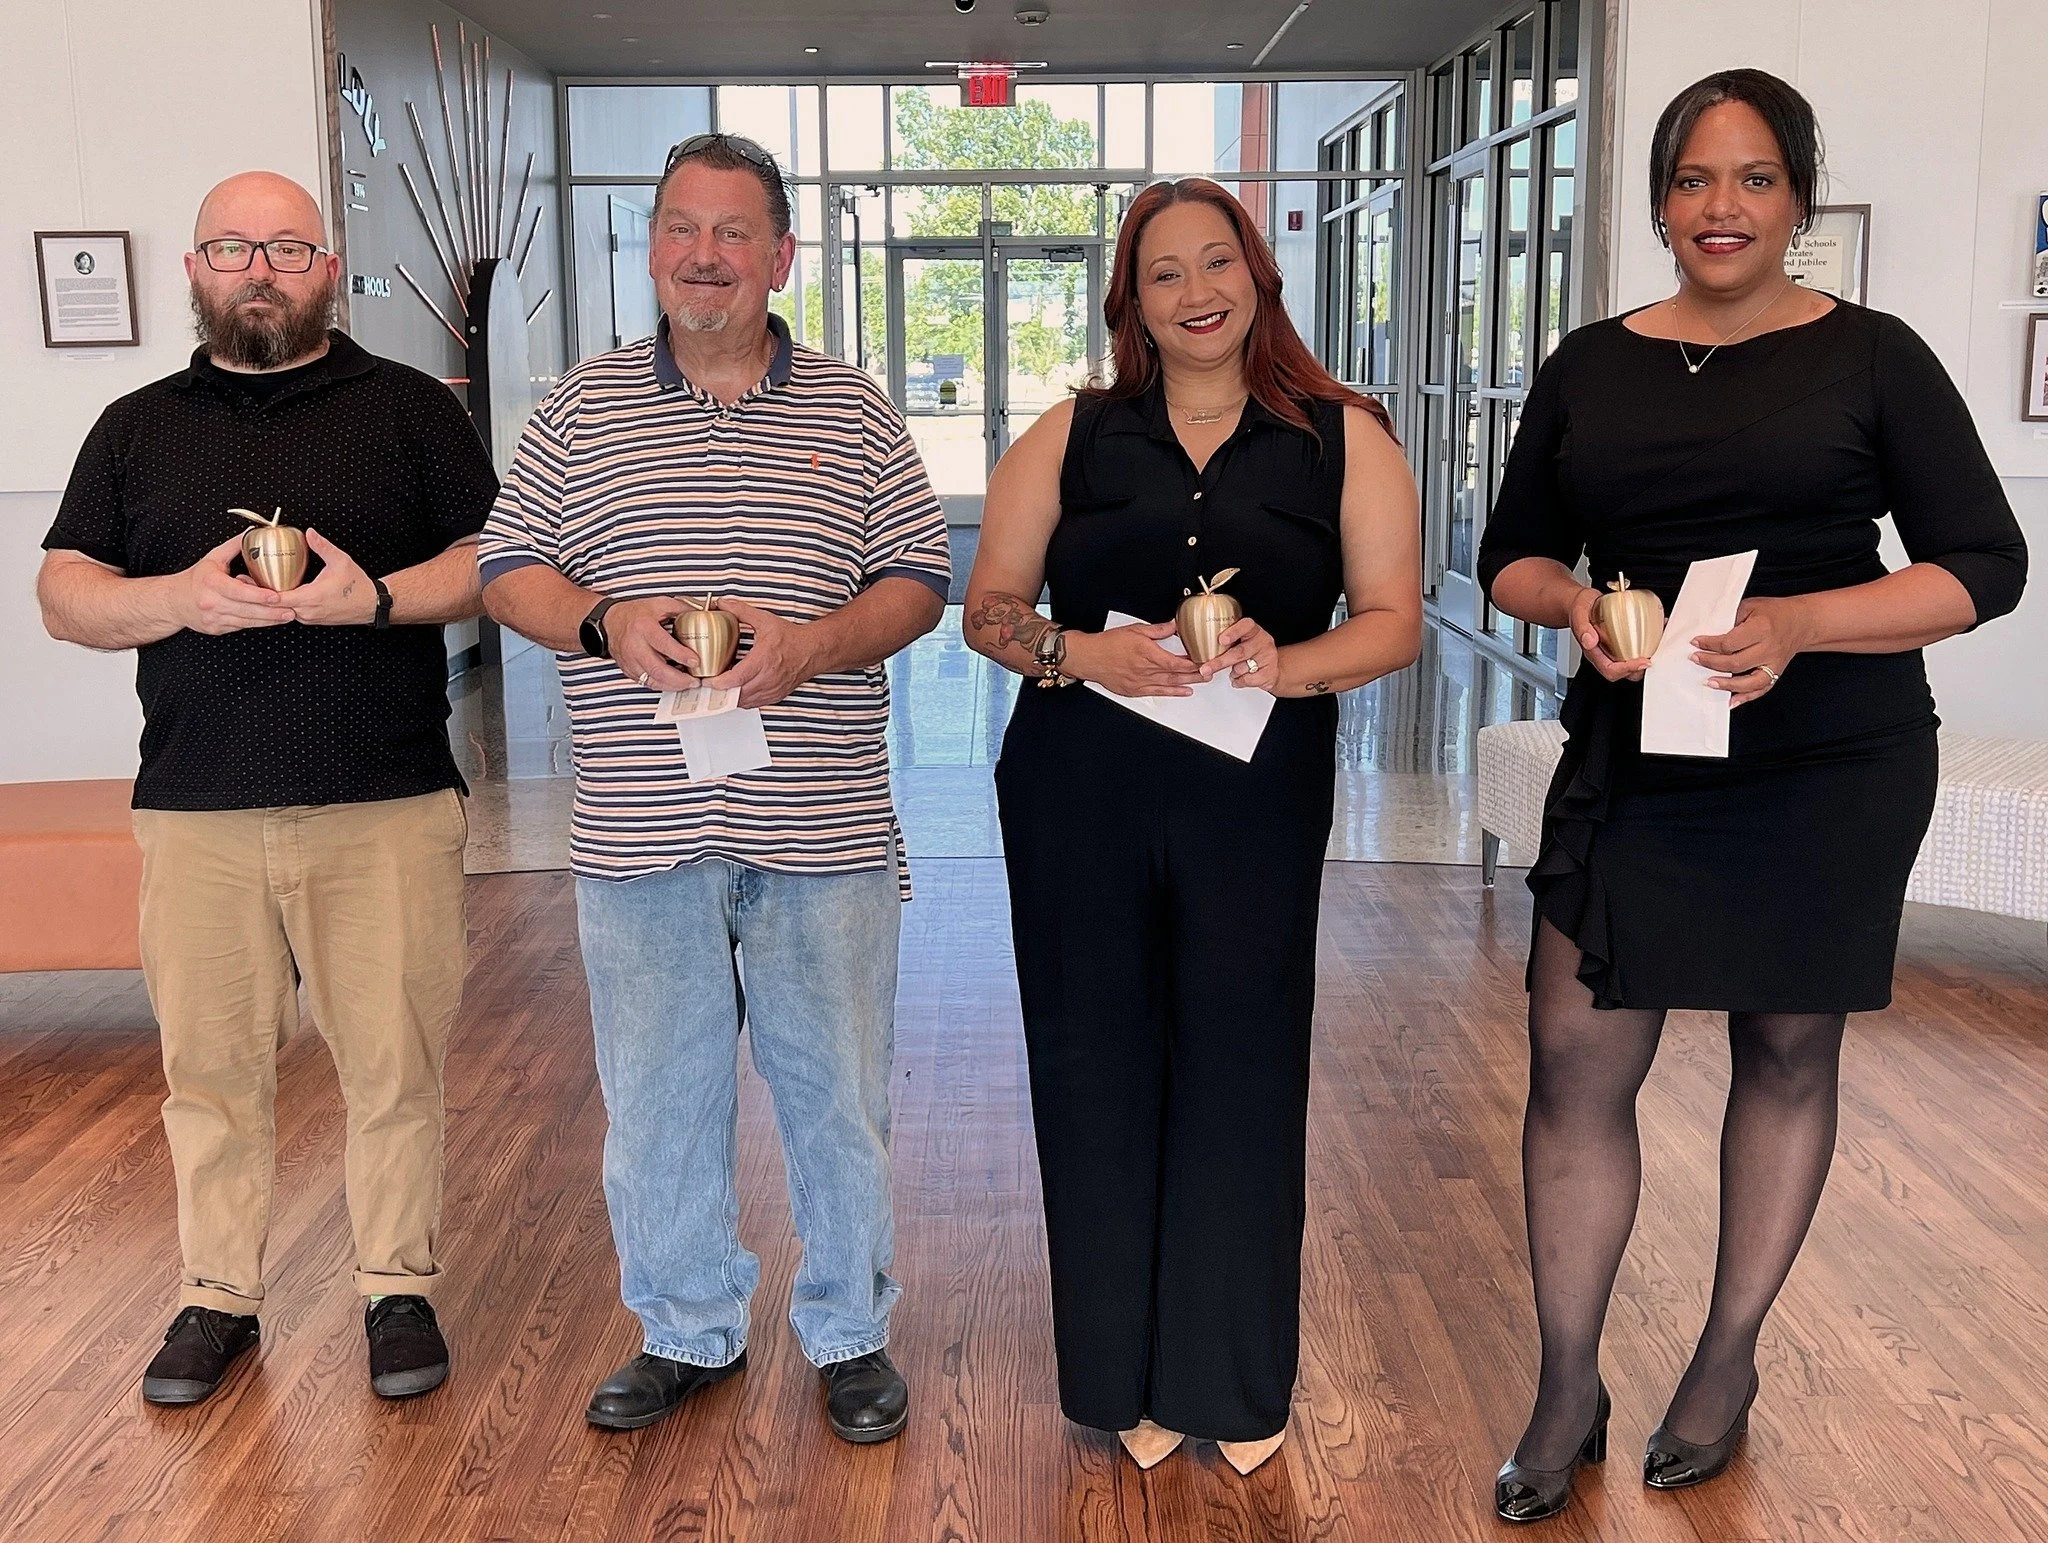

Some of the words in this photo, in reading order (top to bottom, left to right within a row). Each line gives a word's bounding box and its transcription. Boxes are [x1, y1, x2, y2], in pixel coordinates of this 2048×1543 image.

[969, 76, 1007, 104] EXIT
[1804, 240, 1837, 248] Schools
[1798, 259, 1828, 268] Jubilee
